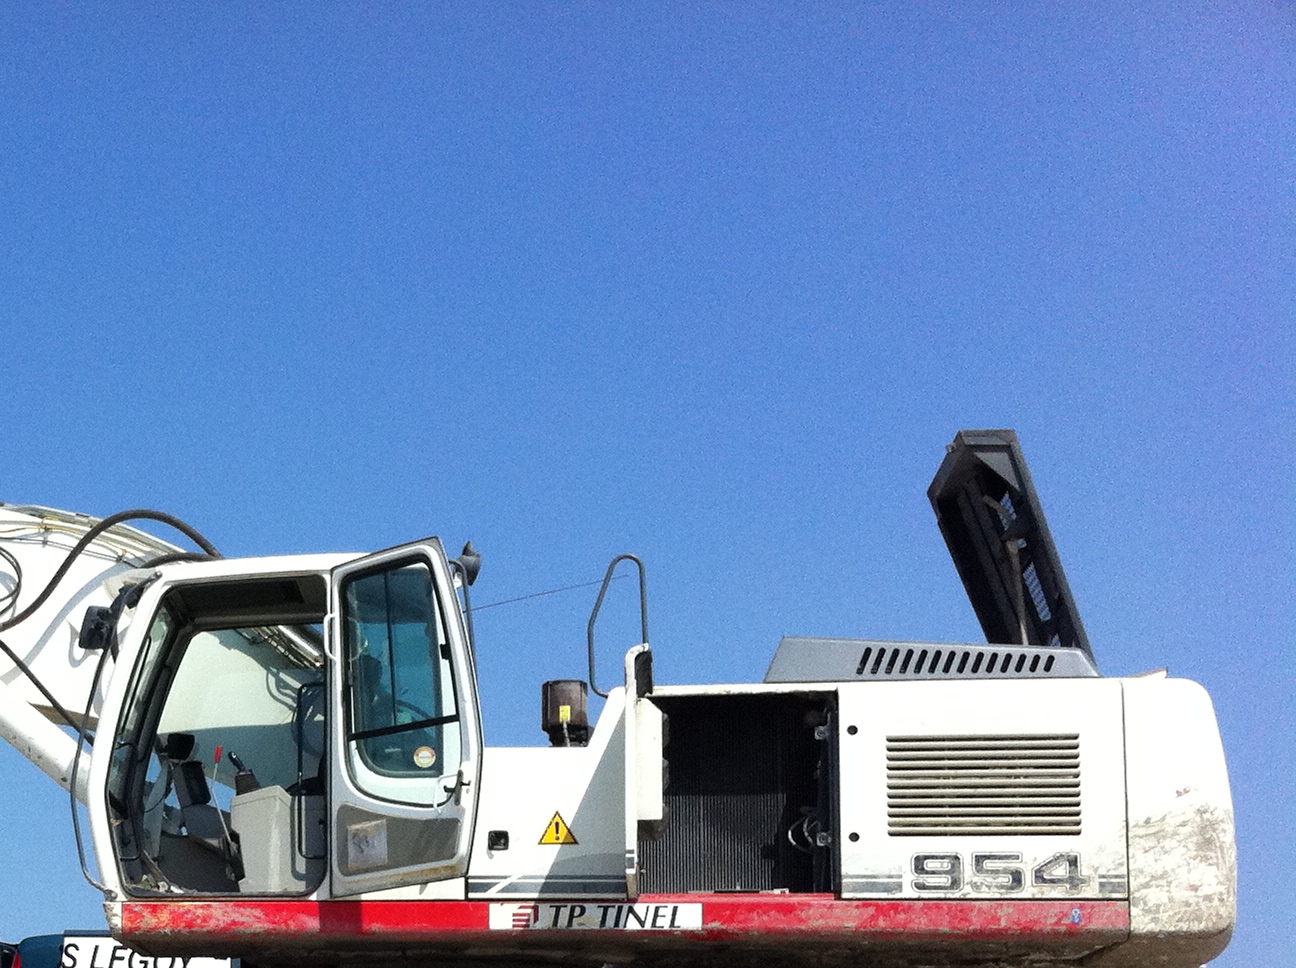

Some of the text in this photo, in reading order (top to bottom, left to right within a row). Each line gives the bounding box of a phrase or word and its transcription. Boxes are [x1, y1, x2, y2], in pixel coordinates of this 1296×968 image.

[911, 852, 1090, 895] 954
[549, 905, 681, 929] TP TINEL
